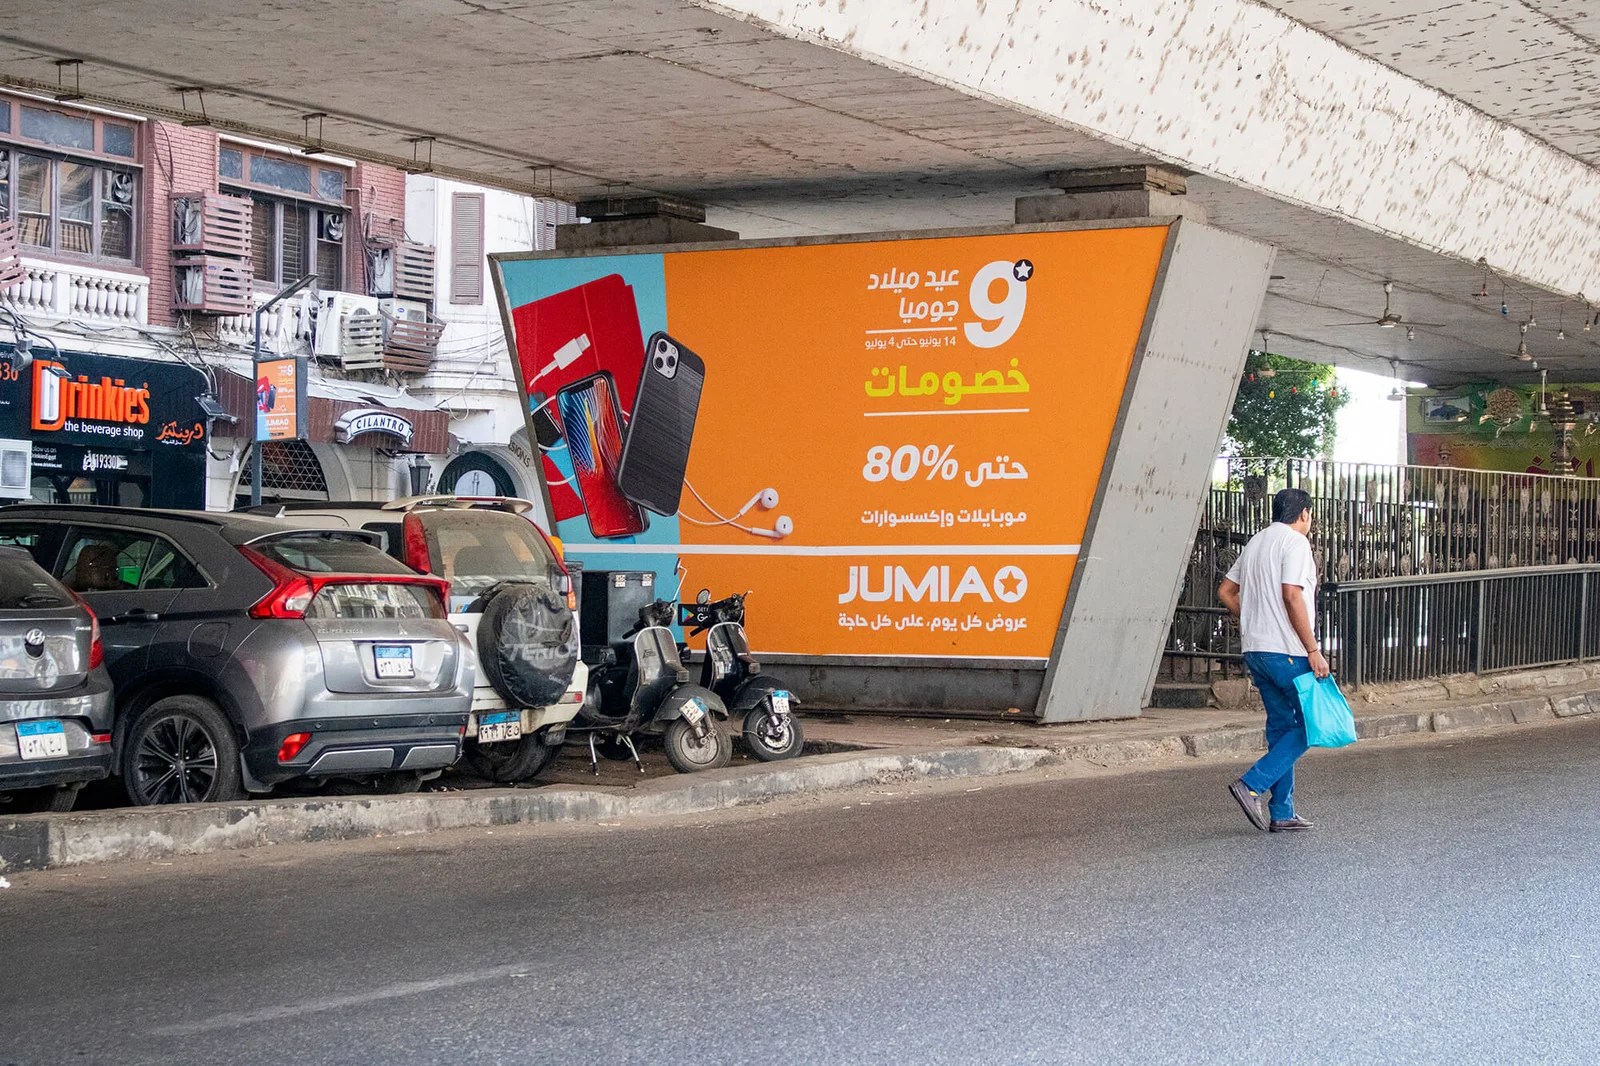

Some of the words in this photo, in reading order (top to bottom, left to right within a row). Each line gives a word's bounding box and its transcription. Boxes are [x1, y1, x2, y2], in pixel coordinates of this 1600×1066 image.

[867, 267, 920, 294] ميلاد
[924, 269, 960, 292] عيد
[899, 297, 960, 324] جوميا
[963, 260, 1028, 349] 9
[865, 339, 887, 350] يوليو
[888, 337, 895, 346] 4
[896, 337, 918, 349] حتى
[920, 336, 942, 348] يونيو
[944, 336, 956, 346] 14
[864, 357, 1030, 406] خصومات
[31, 359, 150, 432] Drinkies
[64, 421, 79, 432] the
[81, 422, 122, 438] beverage
[123, 426, 144, 440] shop
[356, 417, 404, 432] CILANTRO
[862, 444, 959, 482] 80%
[964, 455, 1029, 488] حتى
[861, 510, 954, 528] وإكسسوارات
[957, 509, 1027, 528] موبايلات
[838, 565, 993, 604] JUMIA
[838, 613, 867, 631] حاجة
[870, 614, 892, 630] كل
[895, 614, 923, 630] على
[960, 615, 982, 630] كل
[986, 614, 1027, 632] عروض
